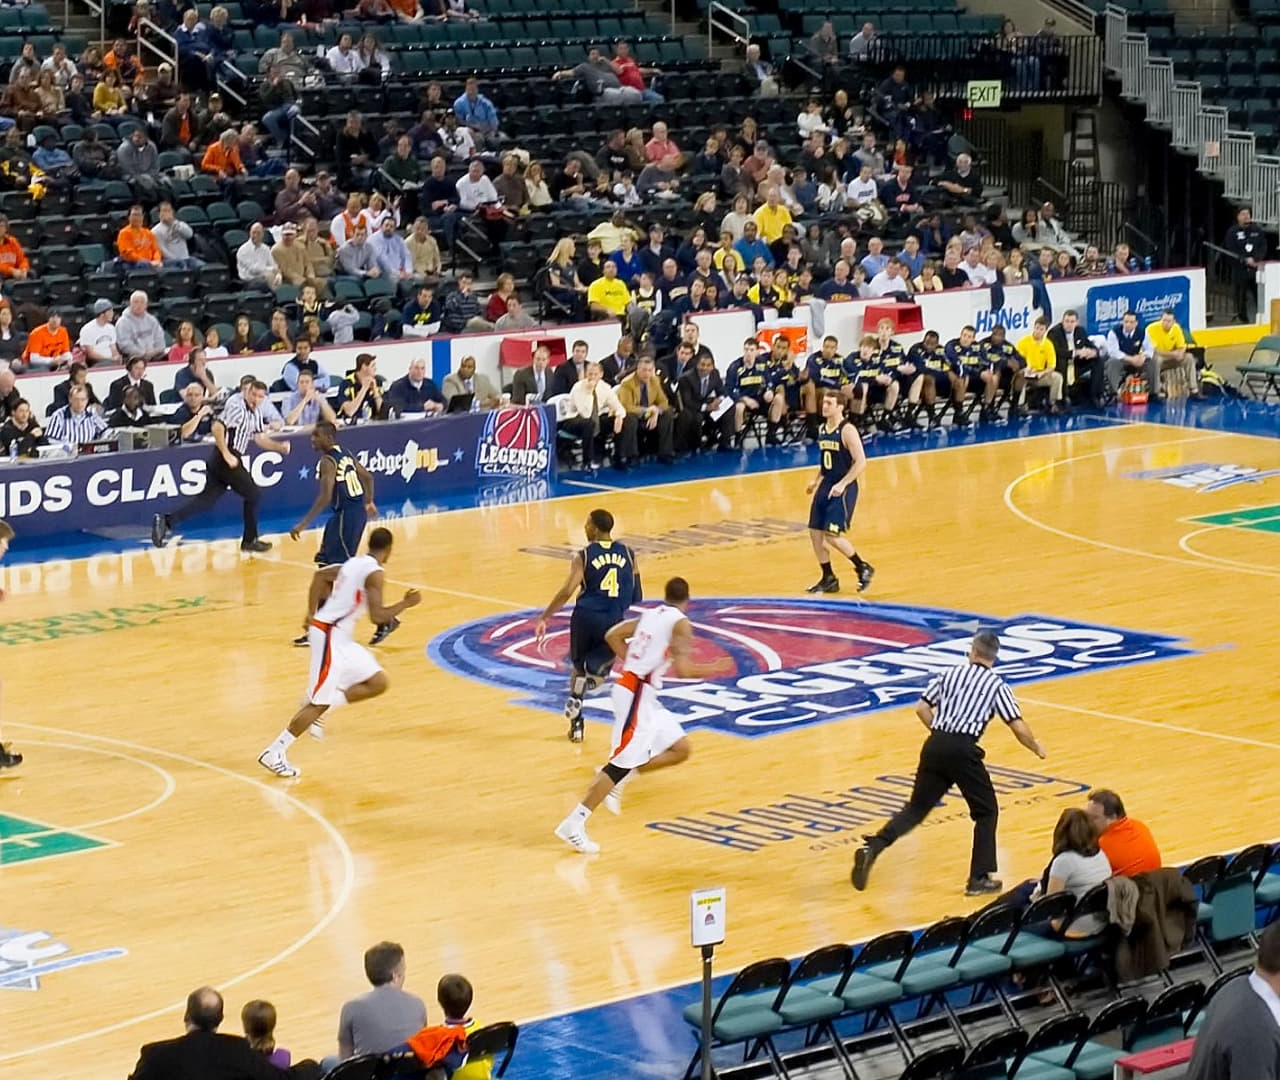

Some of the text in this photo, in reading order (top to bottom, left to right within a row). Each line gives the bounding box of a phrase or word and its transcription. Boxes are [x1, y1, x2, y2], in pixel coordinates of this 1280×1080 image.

[970, 86, 999, 102] EXIT
[976, 306, 1030, 333] HDNet
[479, 442, 548, 468] LEGENDS
[823, 450, 833, 470] 0
[86, 451, 284, 507] CLASC
[483, 463, 544, 479] CLASSIC
[599, 567, 620, 598] 4
[735, 647, 1156, 726] CLASIC
